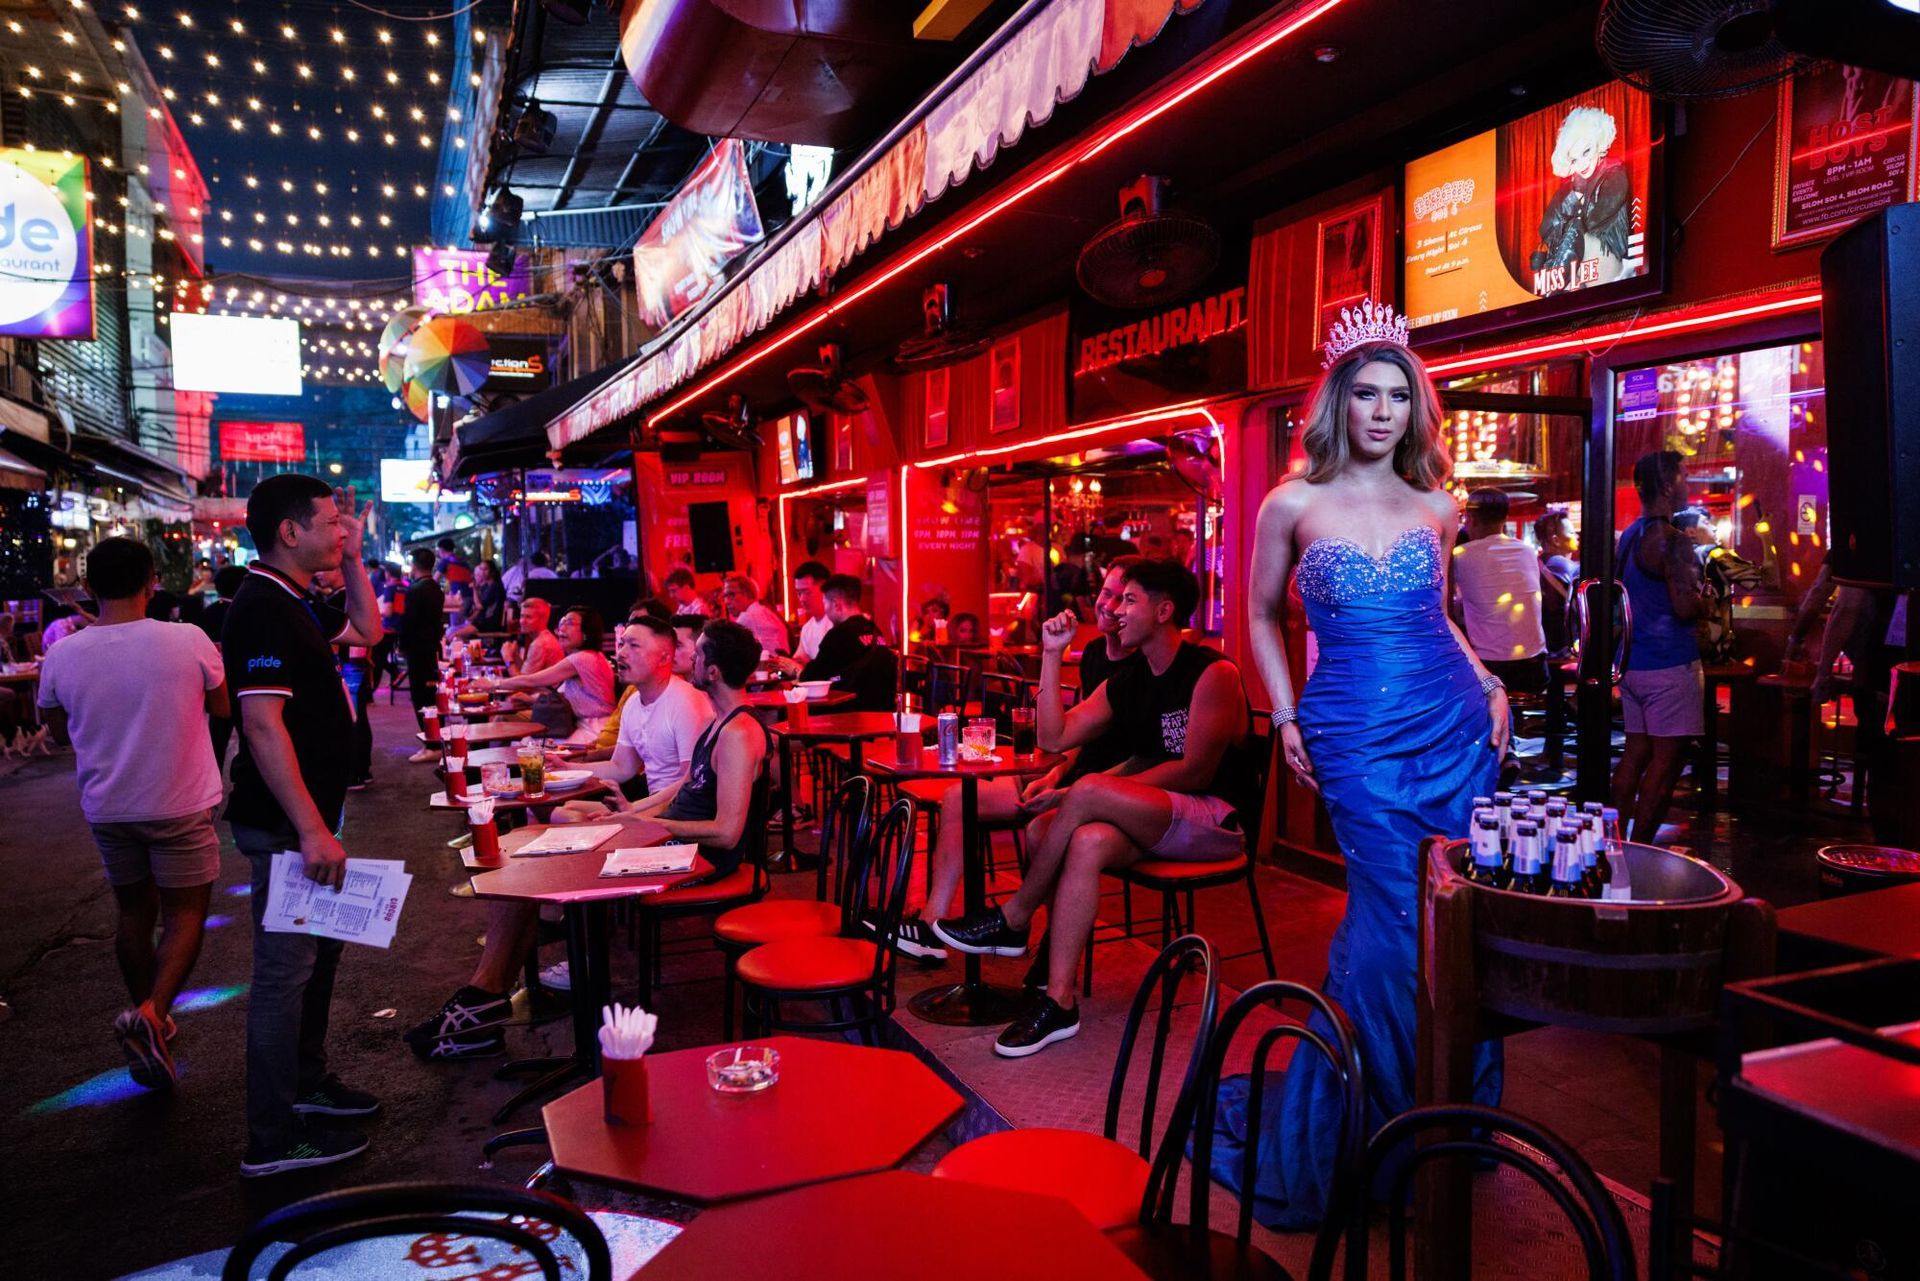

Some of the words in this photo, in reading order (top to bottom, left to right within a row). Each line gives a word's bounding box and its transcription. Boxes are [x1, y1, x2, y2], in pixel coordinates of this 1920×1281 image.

[1827, 163, 1846, 176] 8PM
[1854, 156, 1872, 168] 1AM
[1883, 154, 1906, 165] CIRCUS
[1886, 161, 1905, 171] SILOM
[1824, 174, 1840, 184] LEVEL
[1888, 169, 1899, 178] SOI
[1792, 179, 1815, 190] PRIVATE
[1792, 186, 1813, 197] EVENTS
[1792, 190, 1819, 203] WELCOME
[1801, 198, 1824, 210] SILOM
[1824, 194, 1838, 204] SOI
[1846, 186, 1870, 198] SILOM
[1871, 180, 1894, 192] ROAD
[438, 258, 507, 287] THE
[1080, 286, 1246, 369] RESTAURANT
[490, 355, 544, 374] ctionS
[670, 472, 689, 484] VIP
[693, 471, 725, 484] ROOM
[664, 533, 690, 549] FRE
[918, 542, 947, 550] EVERY
[949, 541, 976, 550] NIGHT
[247, 655, 282, 672] pride
